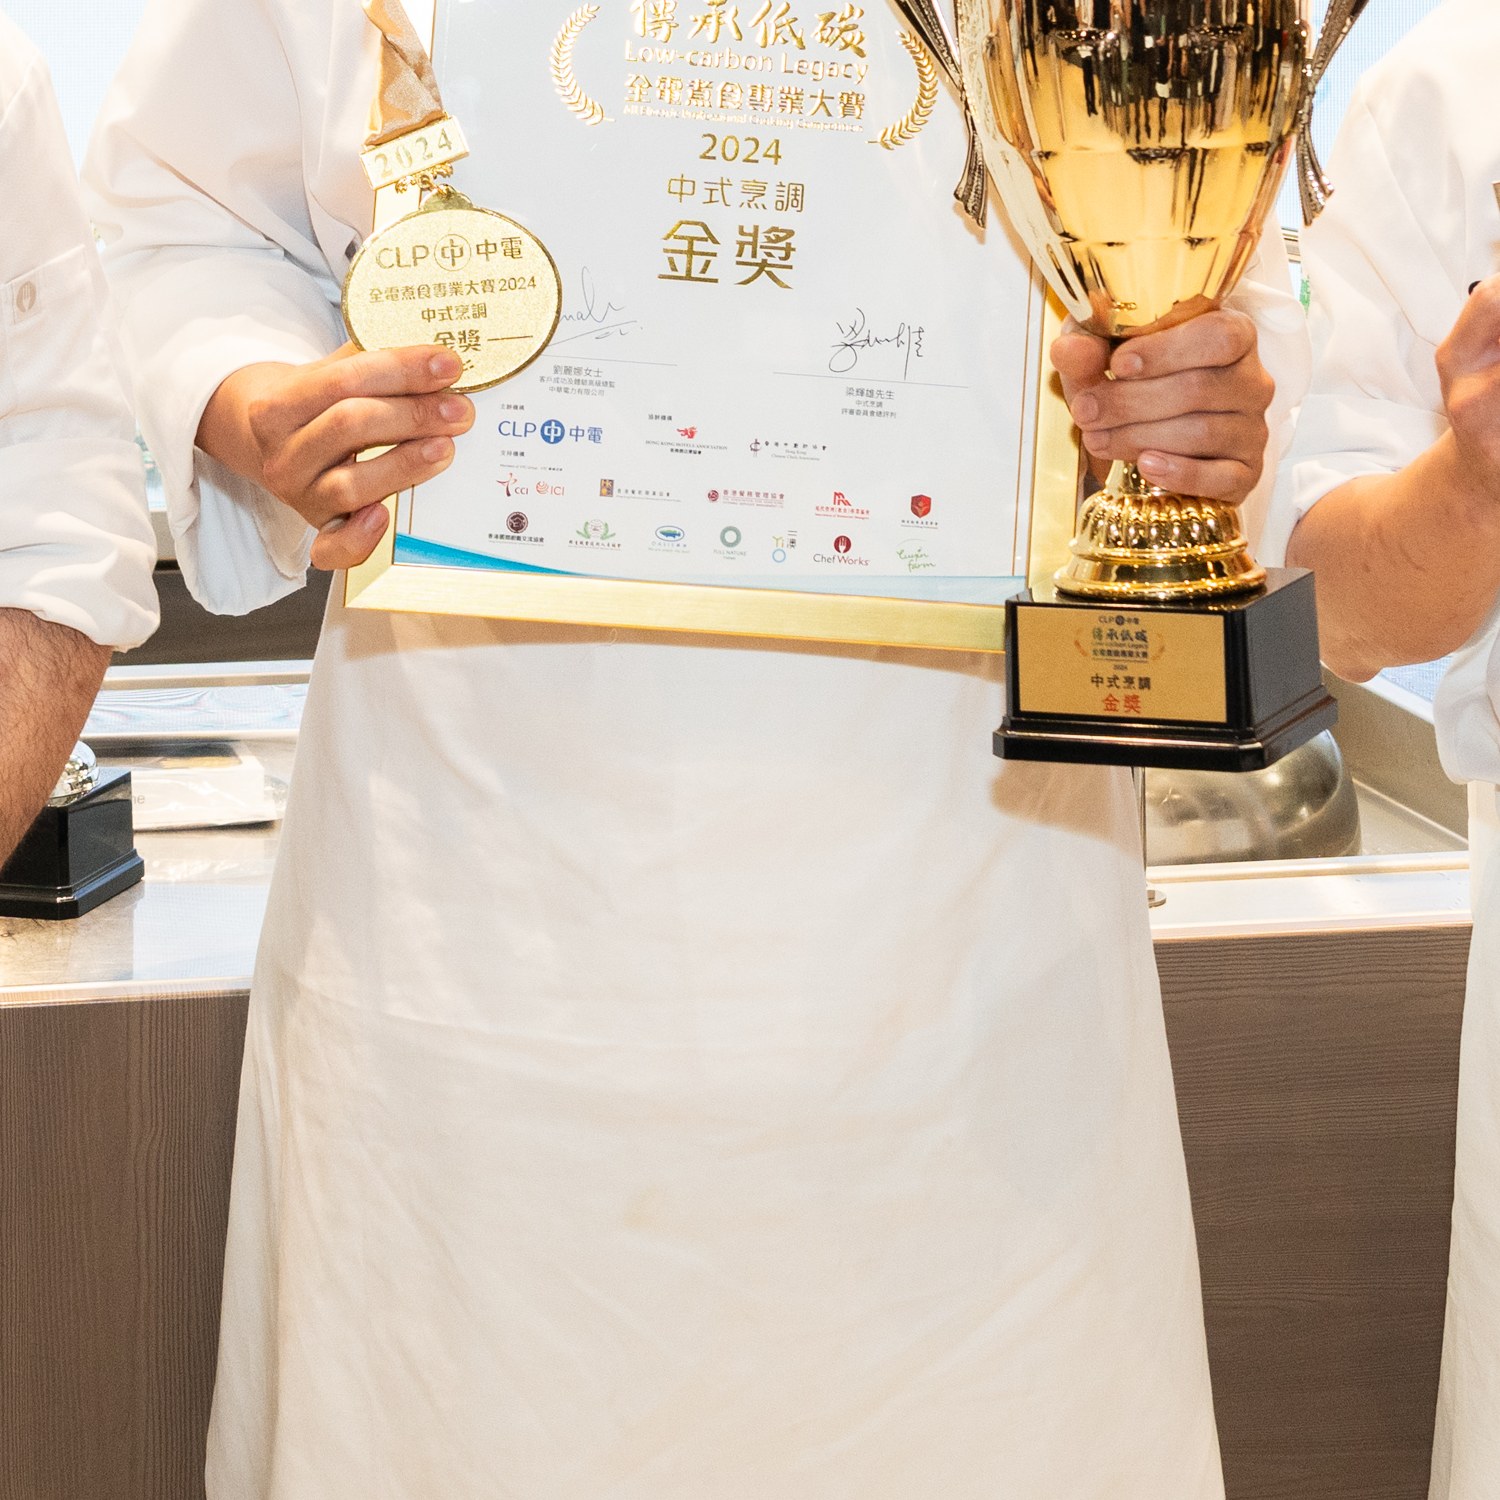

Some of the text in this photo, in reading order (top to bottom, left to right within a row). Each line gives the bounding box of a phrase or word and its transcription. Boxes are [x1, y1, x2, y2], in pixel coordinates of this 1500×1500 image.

[624, 40, 869, 85] Low-carbon Legacy
[624, 73, 866, 120] 全電煮食專業大賽
[373, 127, 453, 179] 2024
[699, 133, 783, 165] 2024
[667, 173, 805, 213] 中式烹調
[375, 236, 523, 270] CLP 中電
[657, 219, 797, 290] 金獎
[421, 302, 488, 323] 中式烹調
[498, 420, 603, 444] CLP 中電
[514, 486, 529, 495] CCI
[550, 485, 565, 496] ICI
[1090, 673, 1151, 691] 中式烹調
[1101, 693, 1142, 714] 金獎
